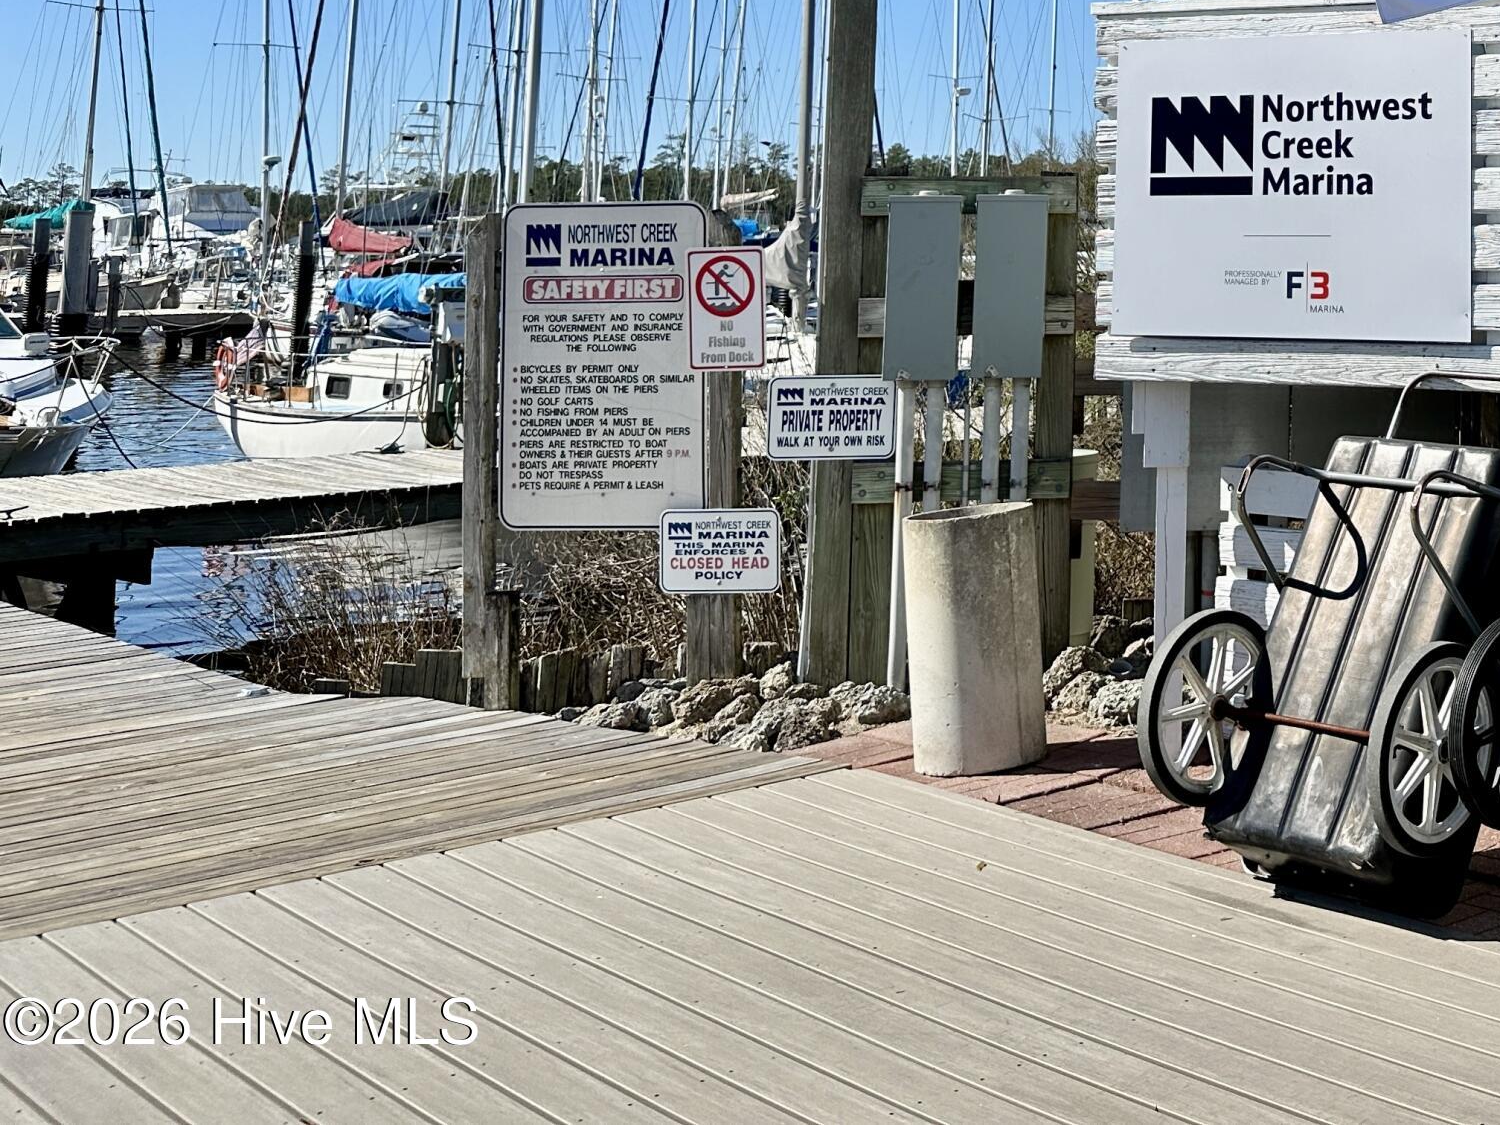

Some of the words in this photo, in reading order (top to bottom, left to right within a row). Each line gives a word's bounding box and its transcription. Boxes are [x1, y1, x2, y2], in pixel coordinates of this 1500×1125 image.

[1262, 92, 1433, 122] Northwest
[1261, 129, 1354, 159] Creek
[1262, 166, 1374, 195] Marina
[568, 224, 636, 244] NORTHWEST
[641, 223, 677, 243] CREEK
[570, 247, 675, 267] MARINA
[1224, 269, 1282, 278] PROFESSIONALLY
[1224, 277, 1259, 286] MANAGED
[1261, 278, 1270, 286] BY
[531, 279, 610, 300] SAFETY
[613, 278, 675, 300] FIRST
[1310, 305, 1344, 313] MARINA
[523, 315, 540, 323] FOR
[544, 314, 567, 323] YOUR
[572, 314, 605, 322] SAFETY
[610, 314, 628, 322] AND
[649, 313, 683, 321] COMPLY
[523, 325, 544, 333] WITH
[549, 325, 605, 333] GOVERNMENT
[611, 324, 628, 332] AND
[720, 320, 733, 331] NO
[593, 334, 626, 342] PLEASE
[709, 336, 746, 347] Fishing
[586, 344, 637, 352] FOLLOWING
[701, 352, 726, 363] From
[729, 351, 754, 362] Dock
[520, 365, 561, 373] BICYCLES
[566, 365, 577, 373] BY
[582, 365, 613, 373] PERMIT
[618, 365, 639, 373] ONLY
[520, 376, 533, 384] NO
[576, 375, 639, 384] SKATEBOARDS
[643, 375, 655, 383] OR
[660, 375, 695, 383] SIMILAR
[521, 386, 561, 394] WHEELED
[566, 386, 591, 394] ITEMS
[596, 386, 608, 394] ON
[613, 385, 629, 394] THE
[634, 385, 658, 393] PIERS
[863, 387, 889, 395] CREEK
[520, 398, 533, 406] NO
[537, 397, 560, 406] GOLF
[565, 397, 594, 406] CARTS
[810, 397, 886, 406] MARINA
[520, 408, 533, 416] NO
[537, 408, 569, 416] FISHING
[574, 407, 599, 416] FROM
[604, 407, 628, 416] PIERS
[520, 418, 562, 427] CHILDREN
[566, 418, 594, 427] UNDER
[599, 418, 608, 426] 14
[613, 418, 637, 426] MUST
[642, 417, 653, 426] BE
[782, 410, 823, 432] PRIVATE
[829, 409, 882, 431] PROPERTY
[520, 428, 581, 437] ACCOMPANIED
[586, 428, 597, 437] BY
[602, 428, 614, 436] AN
[619, 427, 645, 436] ADULT
[648, 427, 661, 435] ON
[666, 427, 690, 435] PIERS
[519, 440, 544, 449] PIERS
[549, 440, 566, 448] ARE
[570, 440, 624, 448] RESTRICTED
[629, 439, 641, 448] TO
[645, 439, 668, 447] BOAT
[777, 436, 799, 447] WALK
[804, 436, 814, 447] AT
[819, 436, 840, 446] YOUR
[844, 436, 862, 446] OWN
[866, 435, 885, 446] RISK
[519, 450, 556, 459] OWNERS
[568, 450, 592, 458] THEIR
[596, 450, 631, 458] GUESTS
[635, 450, 663, 458] AFTER
[667, 450, 672, 458] 9
[519, 460, 547, 469] BOATS
[552, 460, 569, 469] ARE
[574, 460, 608, 468] PRIVATE
[612, 460, 657, 468] PROPERTY
[519, 471, 532, 479] DO
[537, 471, 554, 479] NOT
[558, 470, 603, 479] TRESPASS
[519, 481, 541, 490] PETS
[544, 481, 581, 490] REQUIRE
[584, 481, 590, 489] A
[593, 481, 625, 489] PERMIT
[627, 481, 632, 489] &
[635, 481, 664, 489] LEASH
[695, 521, 742, 530] NORTHWEST
[746, 521, 771, 529] CREEK
[698, 531, 770, 539] MARINA
[670, 557, 723, 569] CLOSED
[732, 557, 769, 569] HEAD
[695, 571, 743, 579] POLICY
